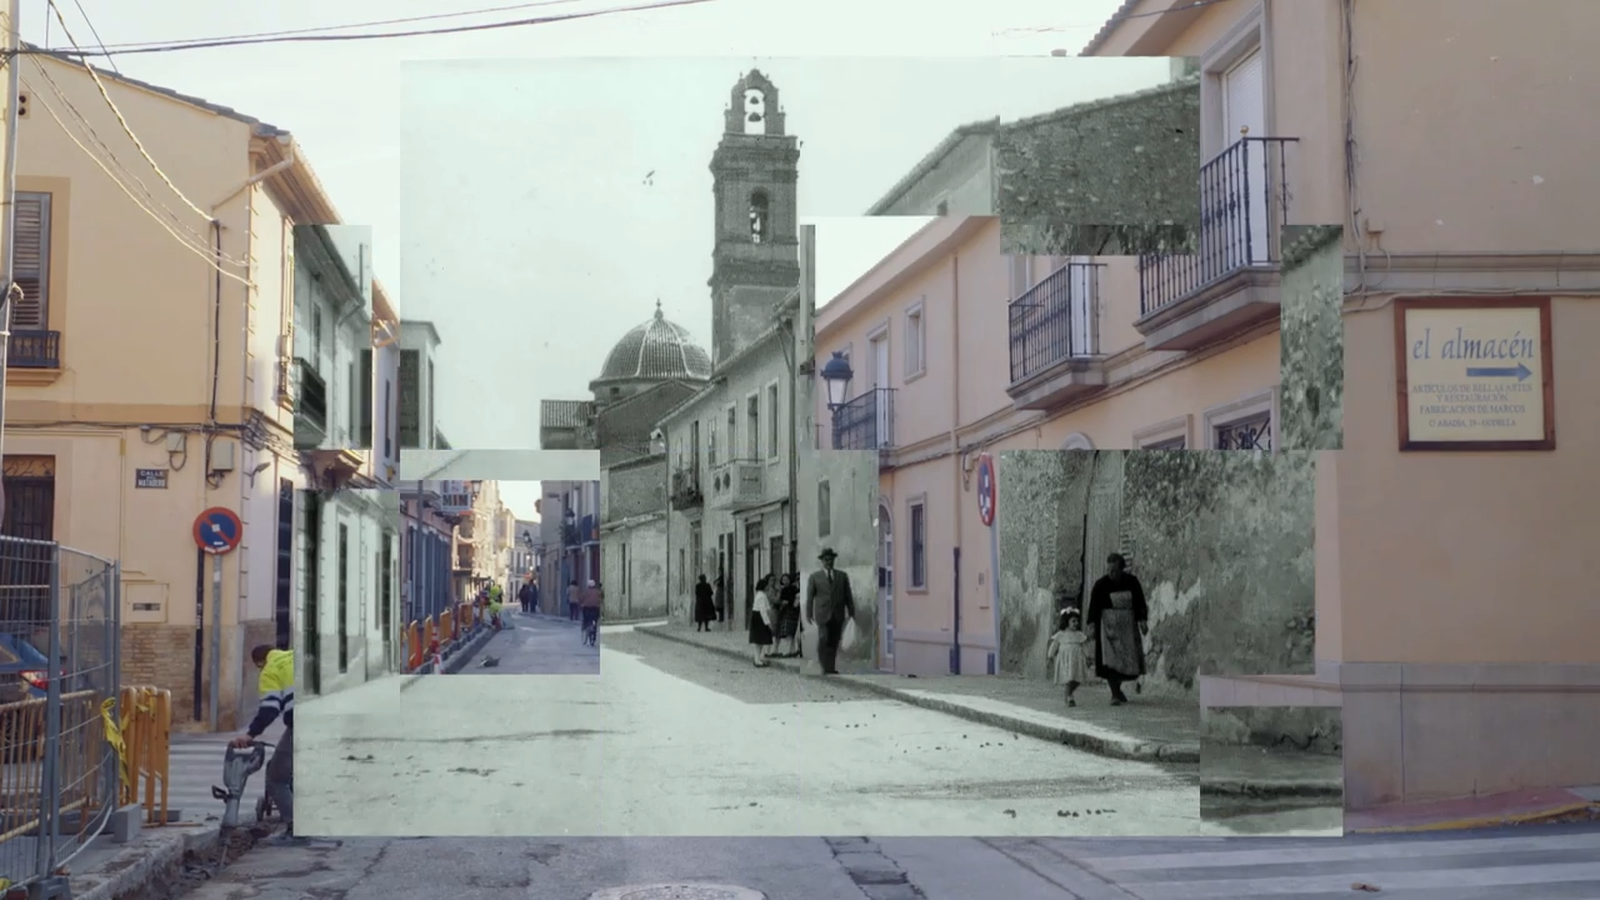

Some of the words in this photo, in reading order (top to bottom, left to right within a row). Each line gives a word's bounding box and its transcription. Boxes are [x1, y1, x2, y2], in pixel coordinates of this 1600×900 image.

[1412, 327, 1431, 360] el
[1441, 326, 1534, 360] almacén
[1459, 384, 1470, 393] DE
[1472, 383, 1504, 393] BELLAS
[1505, 383, 1533, 393] ARTES
[1436, 394, 1443, 402] Y
[1419, 404, 1476, 415] FABRICACIÓN
[1477, 405, 1487, 414] DE
[1489, 404, 1526, 414] MARCOS
